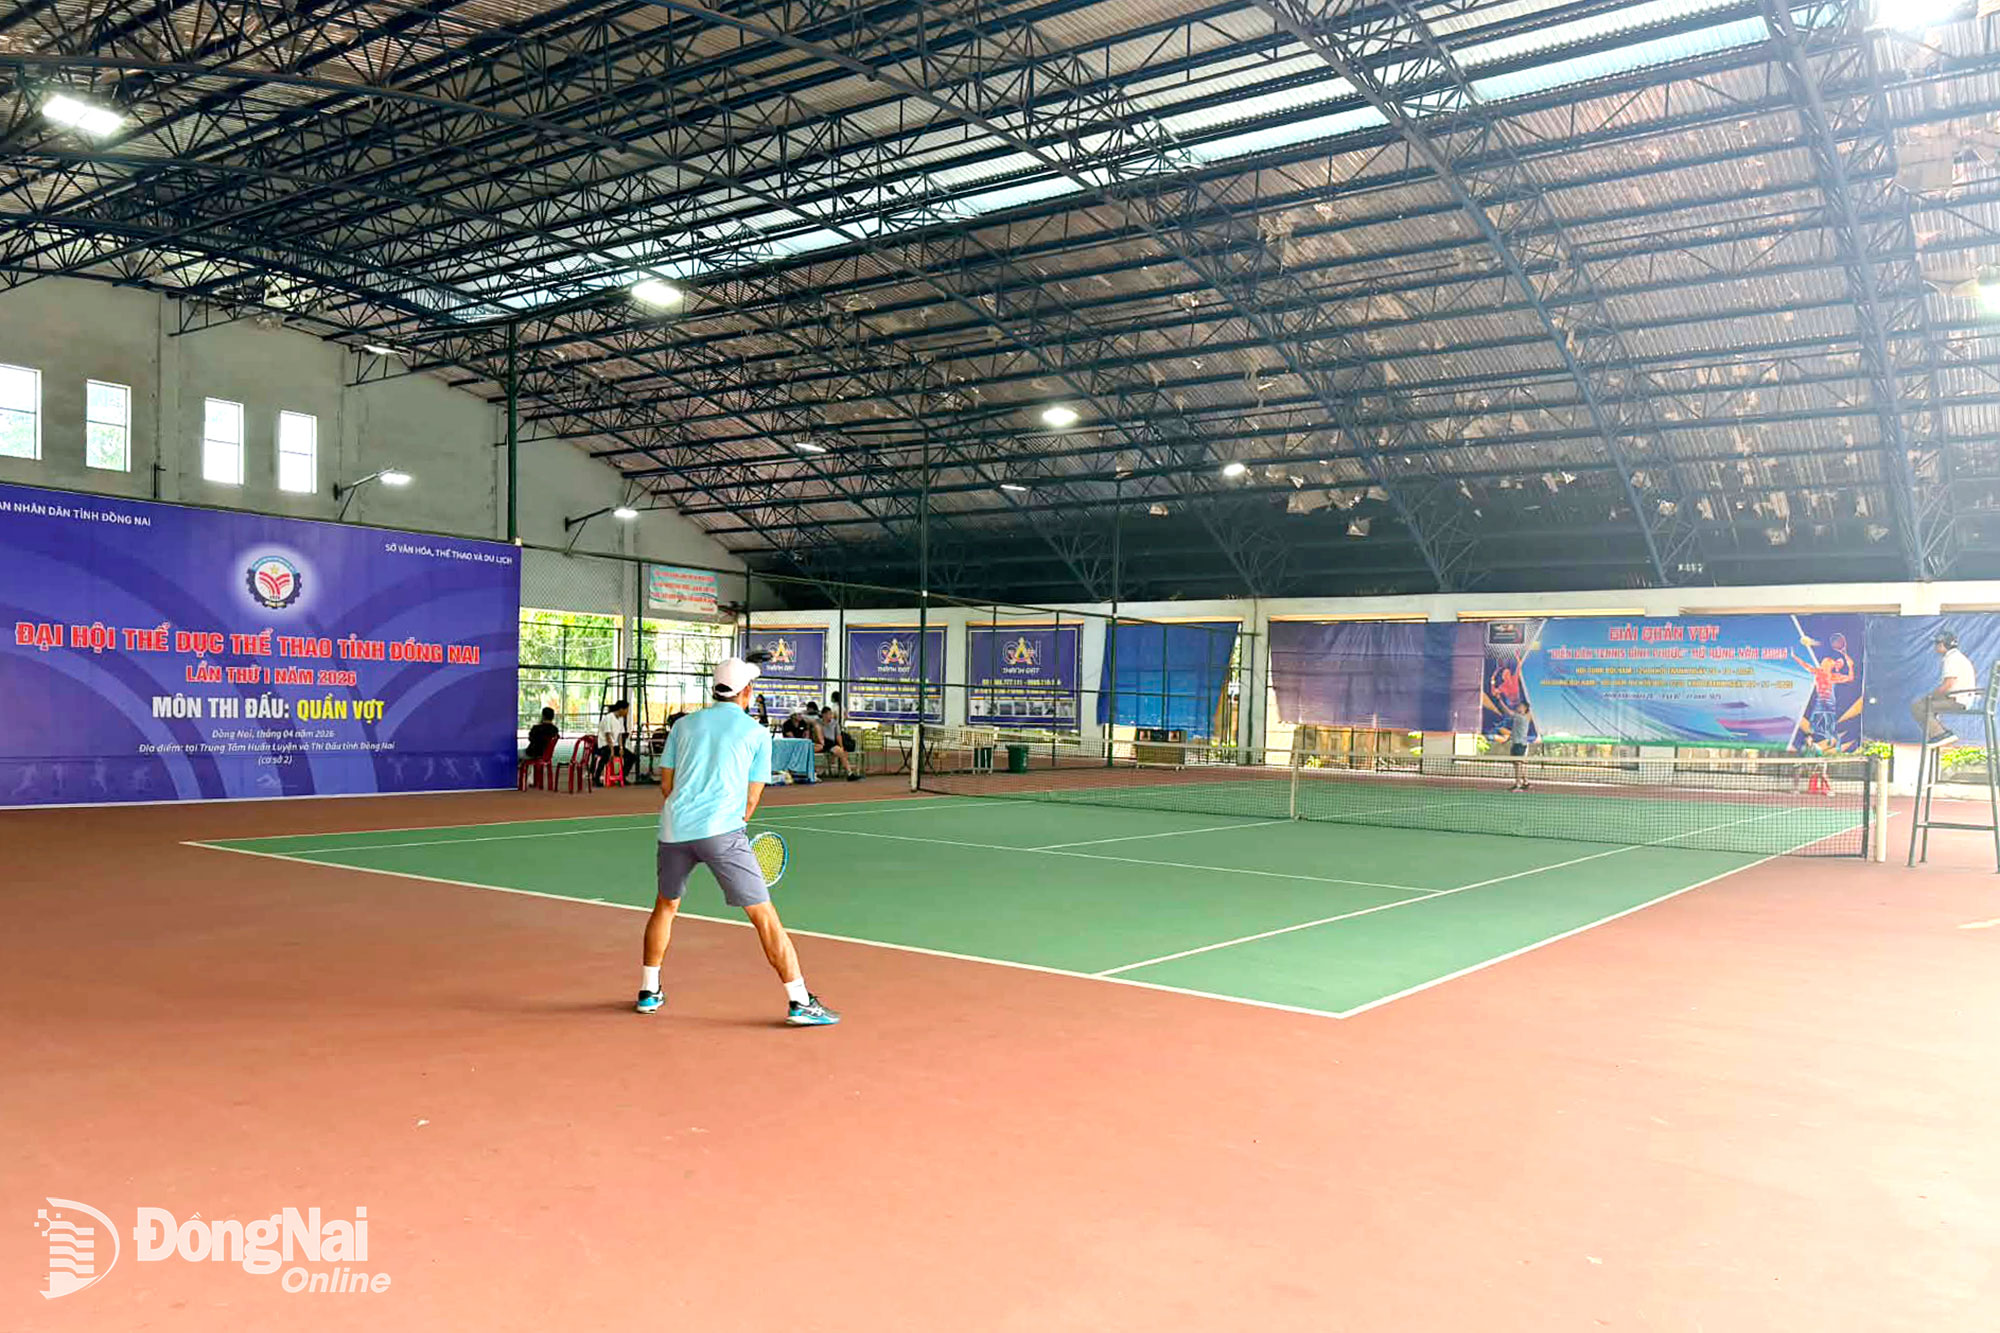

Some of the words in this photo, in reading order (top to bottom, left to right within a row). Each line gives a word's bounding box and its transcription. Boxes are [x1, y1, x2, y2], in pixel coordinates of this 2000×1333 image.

[14, 502, 46, 515] NHÂN
[49, 506, 71, 518] DÂN
[101, 512, 132, 525] ĐỒNG
[134, 516, 151, 526] NAI
[452, 550, 472, 561] THAO
[15, 622, 64, 651] ĐẠI
[70, 621, 116, 653] HỘI
[122, 620, 170, 652] THỂ
[175, 630, 224, 658] DỤC
[230, 627, 274, 656] THỂ
[277, 636, 332, 658] THAO
[337, 633, 385, 660] TỈNH
[447, 644, 481, 665] NAI
[186, 660, 222, 683] LẦN
[225, 664, 261, 684] THỨ
[274, 666, 314, 685] NĂM
[317, 669, 357, 686] 2026
[152, 692, 203, 719] MÔN
[208, 697, 239, 719] THI
[244, 691, 291, 719] ĐẤU:
[296, 692, 348, 722] QUẦN
[352, 698, 385, 725] VỢT
[256, 729, 281, 741] tháng
[283, 730, 293, 738] 04
[295, 730, 314, 738] năm
[315, 730, 336, 738] 2026
[185, 743, 198, 755] tại
[200, 743, 225, 754] Trung
[227, 742, 246, 752] Tâm
[299, 743, 309, 751] và
[311, 742, 323, 751] Thi
